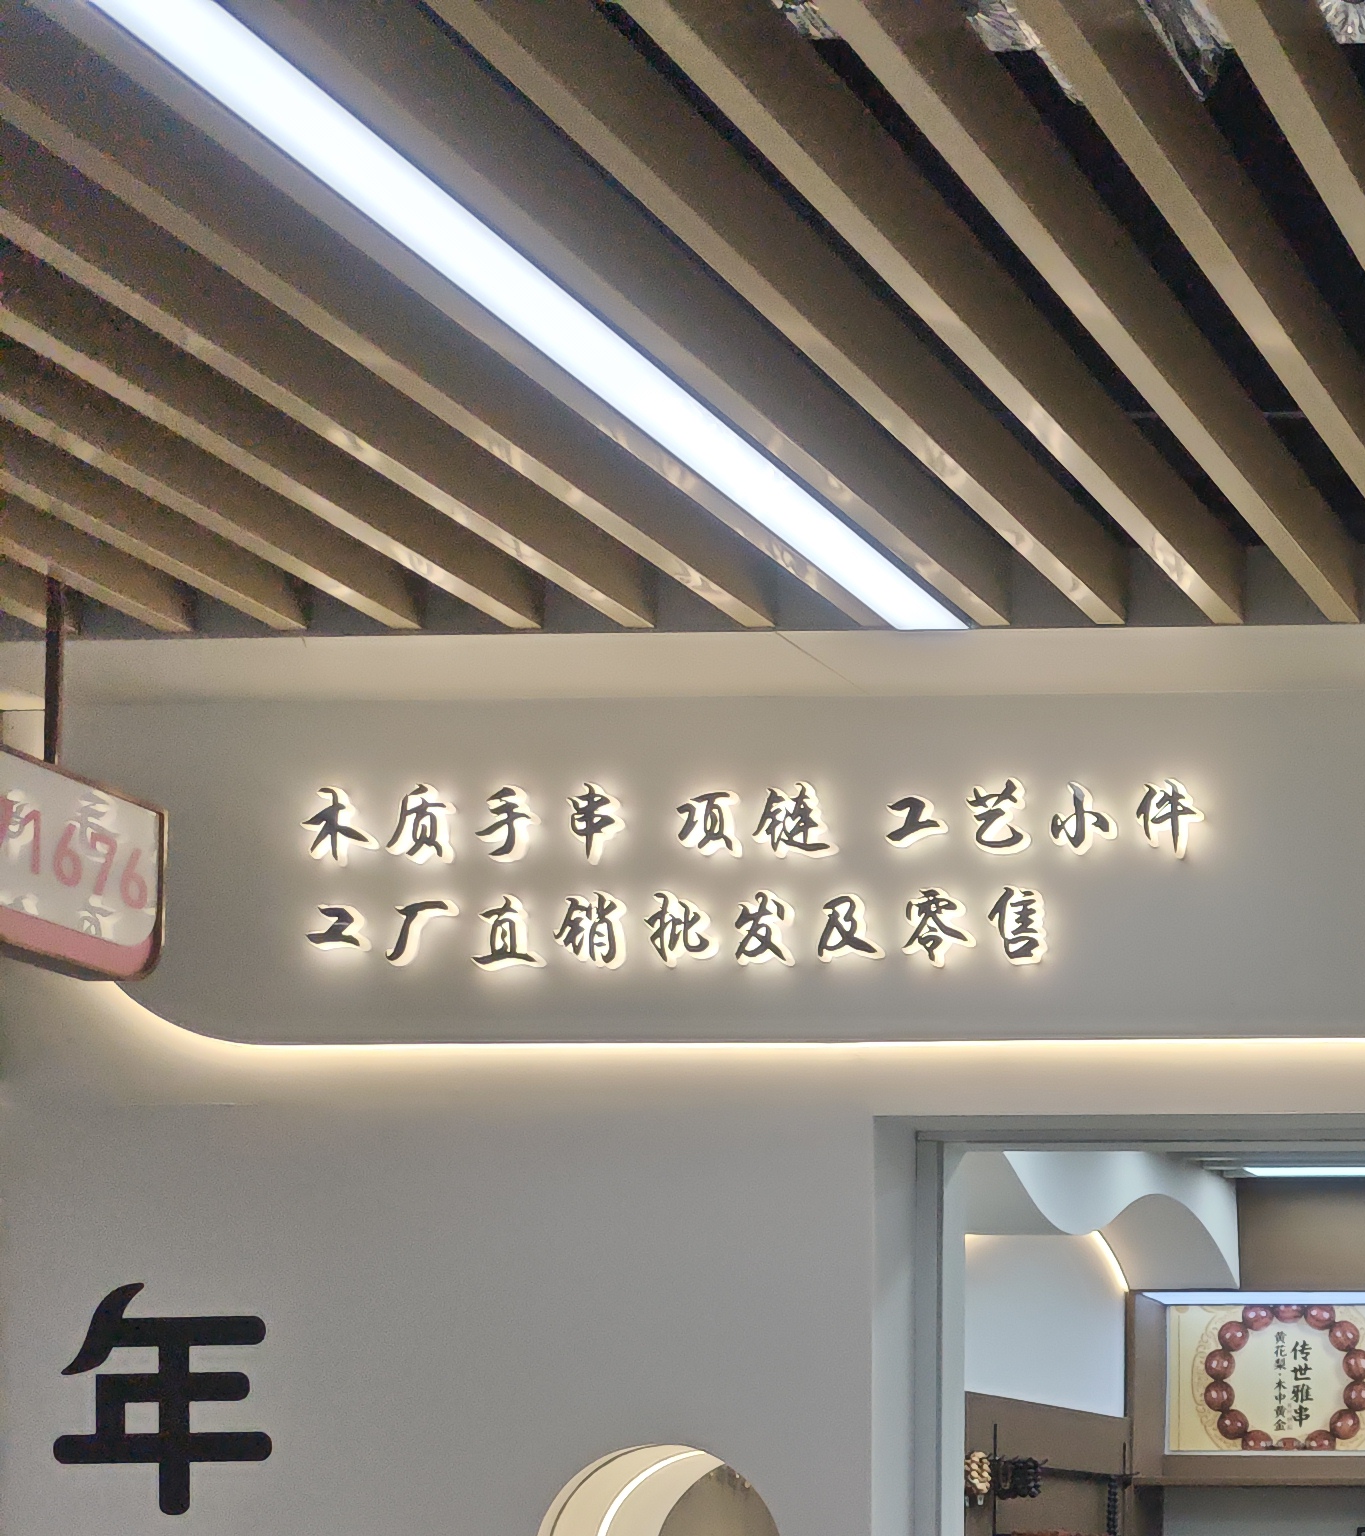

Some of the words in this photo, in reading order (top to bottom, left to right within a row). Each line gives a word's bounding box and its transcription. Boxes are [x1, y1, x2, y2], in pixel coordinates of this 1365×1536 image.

[303, 781, 616, 860] 木质手串
[675, 784, 835, 857] 项链
[885, 778, 1202, 858] 工艺小件
[306, 886, 1046, 966] 工厂直销批发及零售
[1290, 1339, 1314, 1428] 传世雅串
